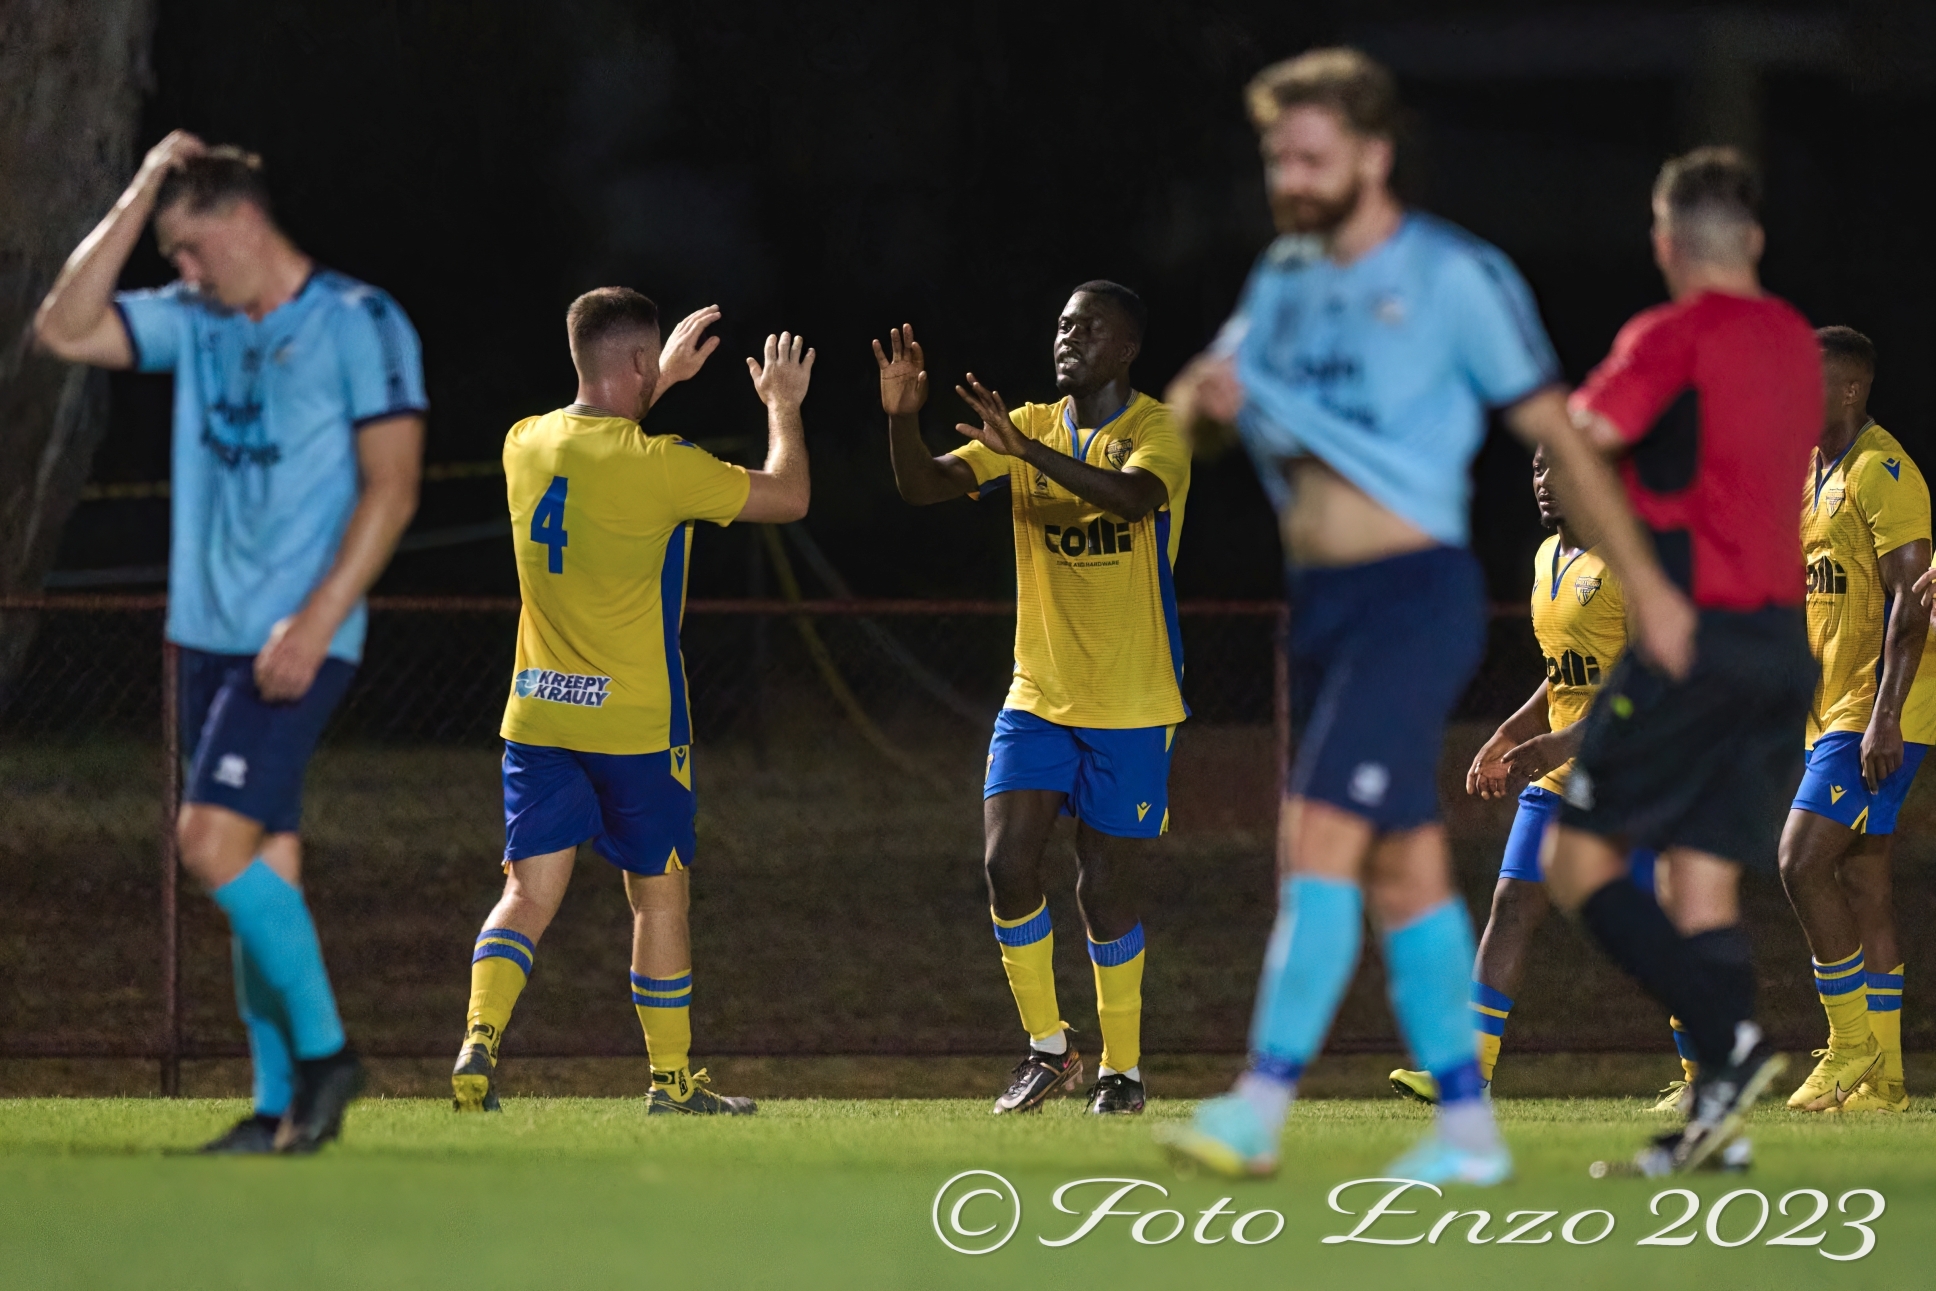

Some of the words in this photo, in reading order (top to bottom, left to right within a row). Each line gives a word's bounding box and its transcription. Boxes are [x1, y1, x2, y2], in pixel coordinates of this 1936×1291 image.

[530, 475, 568, 574] 4
[539, 670, 611, 691] KREEPY
[533, 684, 610, 707] KRAULY
